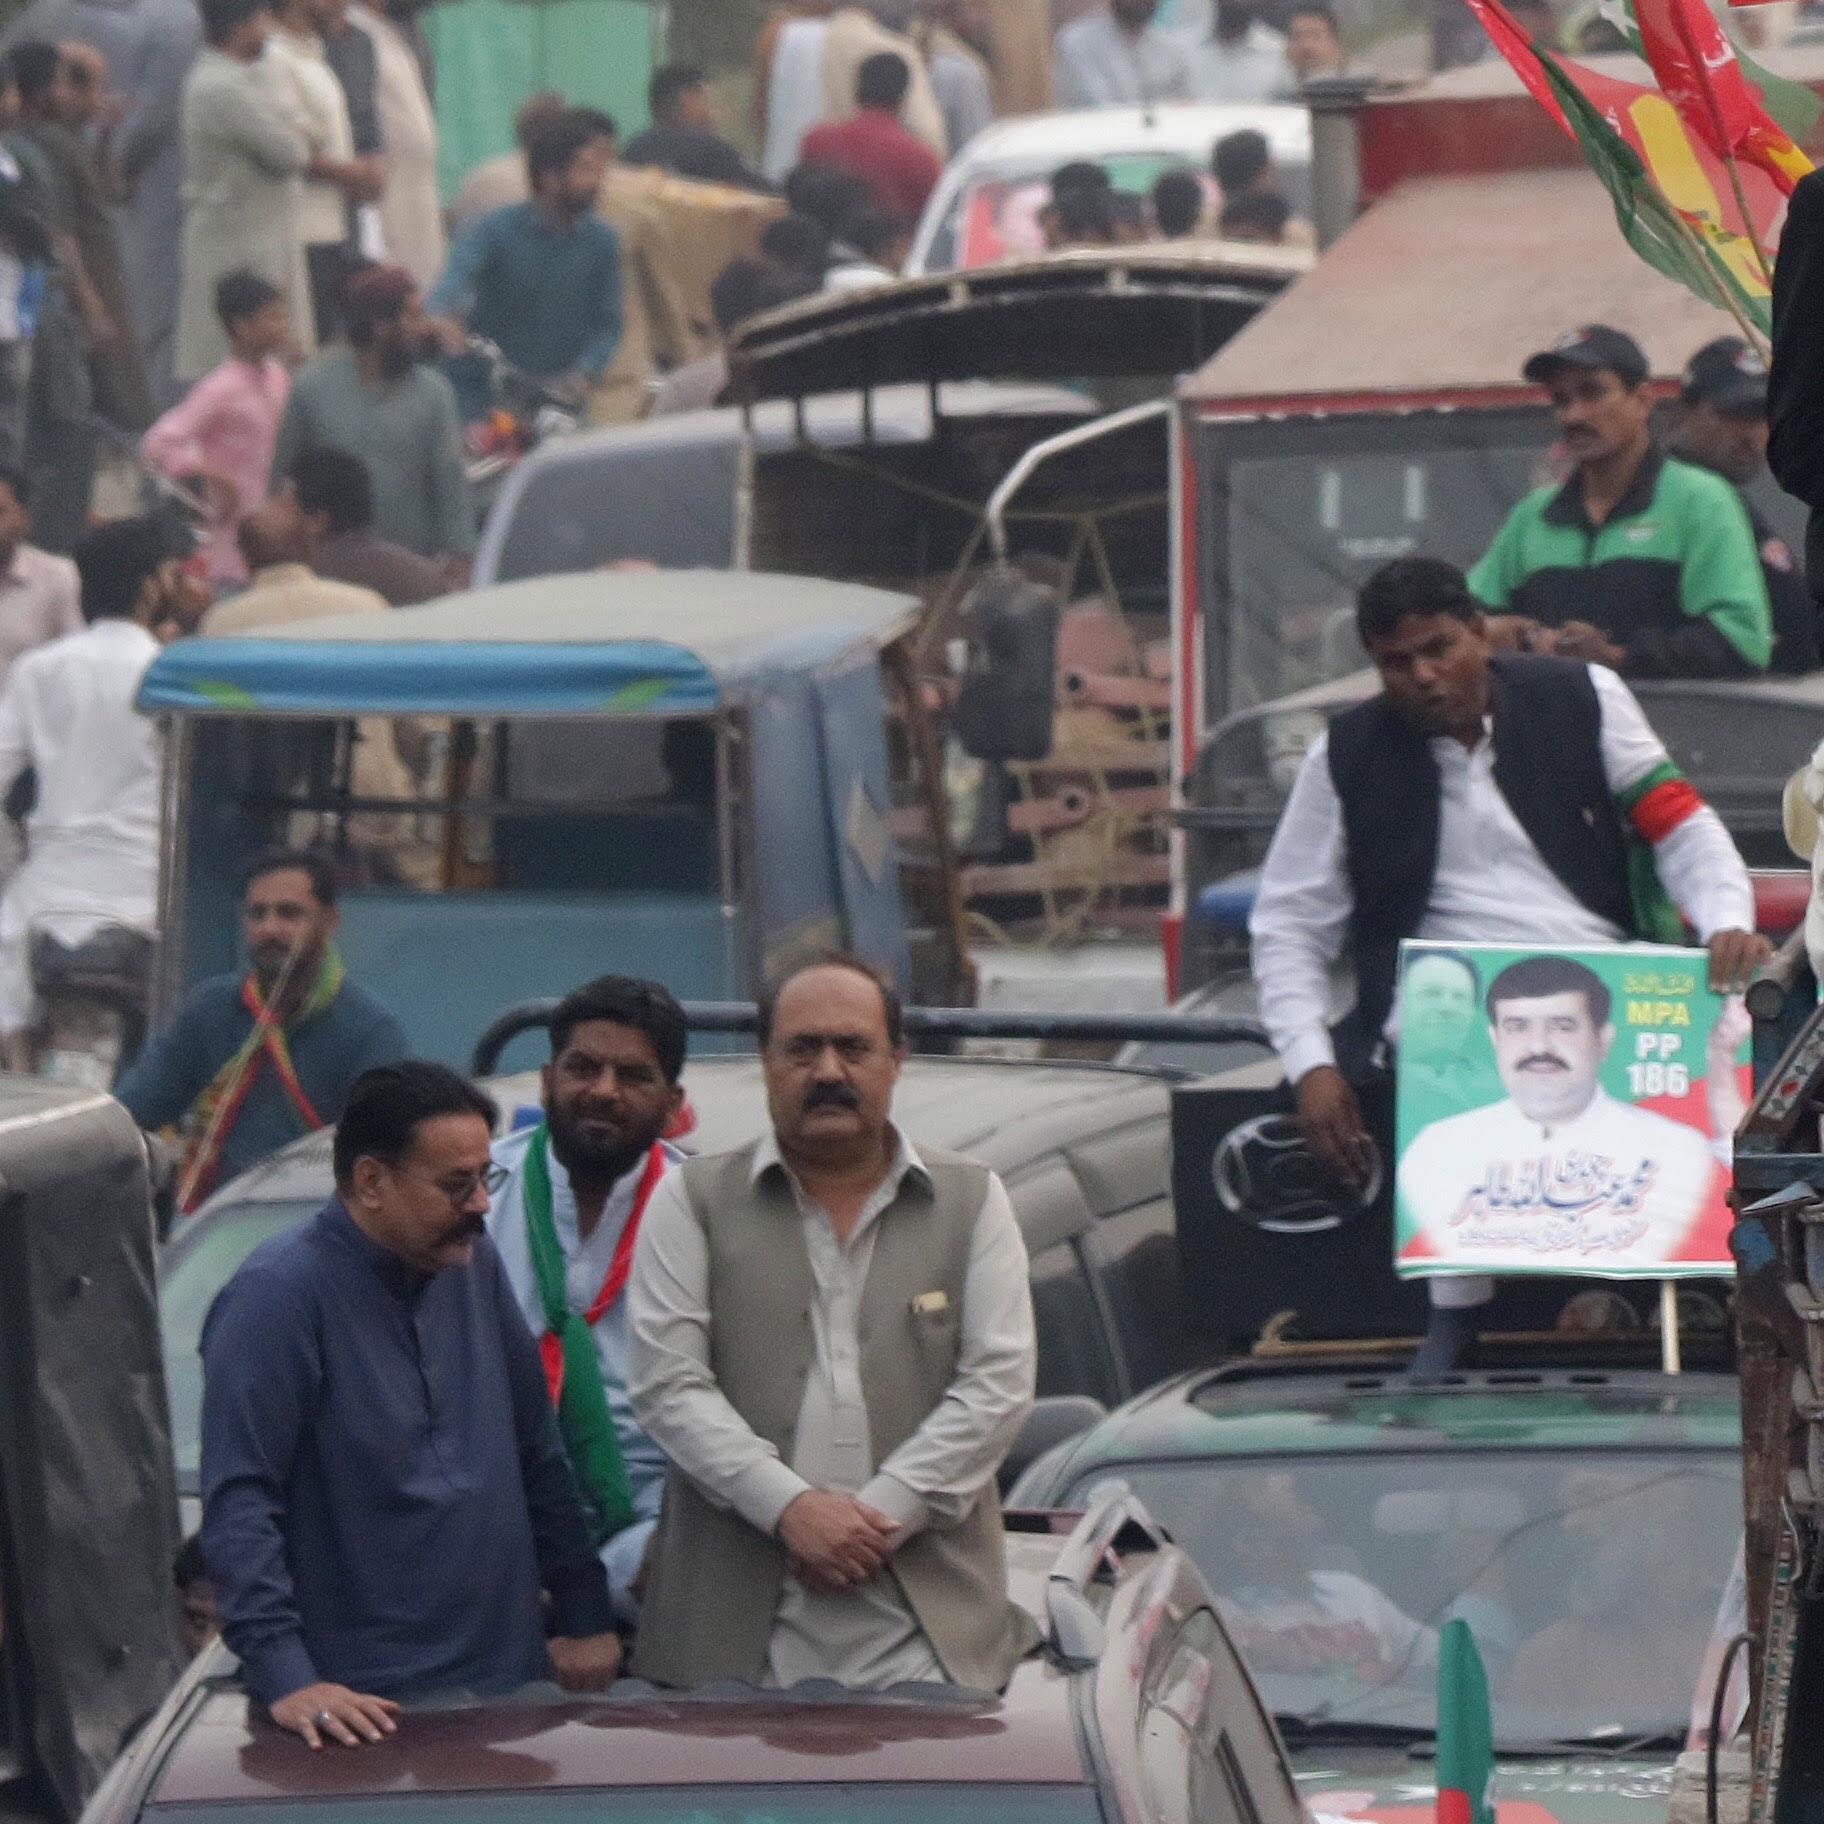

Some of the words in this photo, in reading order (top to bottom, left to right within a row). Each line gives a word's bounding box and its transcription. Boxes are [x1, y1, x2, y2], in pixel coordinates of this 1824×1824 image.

[1627, 1001, 1692, 1027] MPA
[1635, 1031, 1683, 1061] PP
[1626, 1062, 1690, 1099] 186
